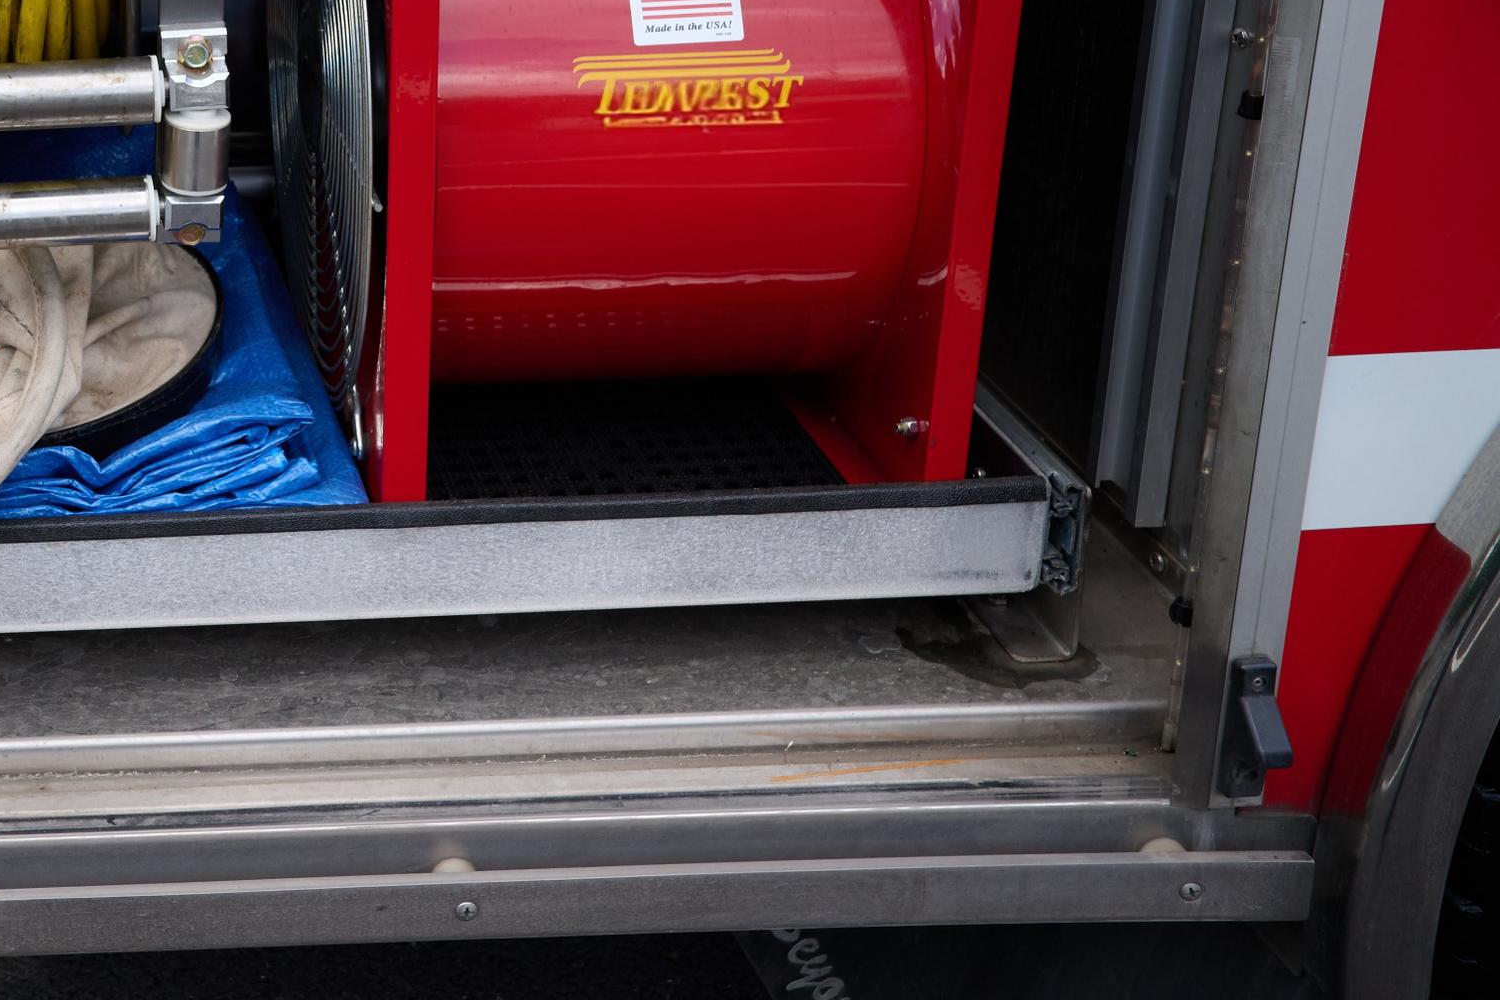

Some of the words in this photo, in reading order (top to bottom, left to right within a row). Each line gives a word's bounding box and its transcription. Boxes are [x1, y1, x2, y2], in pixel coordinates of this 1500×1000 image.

[645, 23, 672, 33] Made
[674, 23, 686, 32] in
[687, 22, 703, 31] the
[705, 20, 733, 30] USA!
[587, 66, 804, 116] TEMPEST
